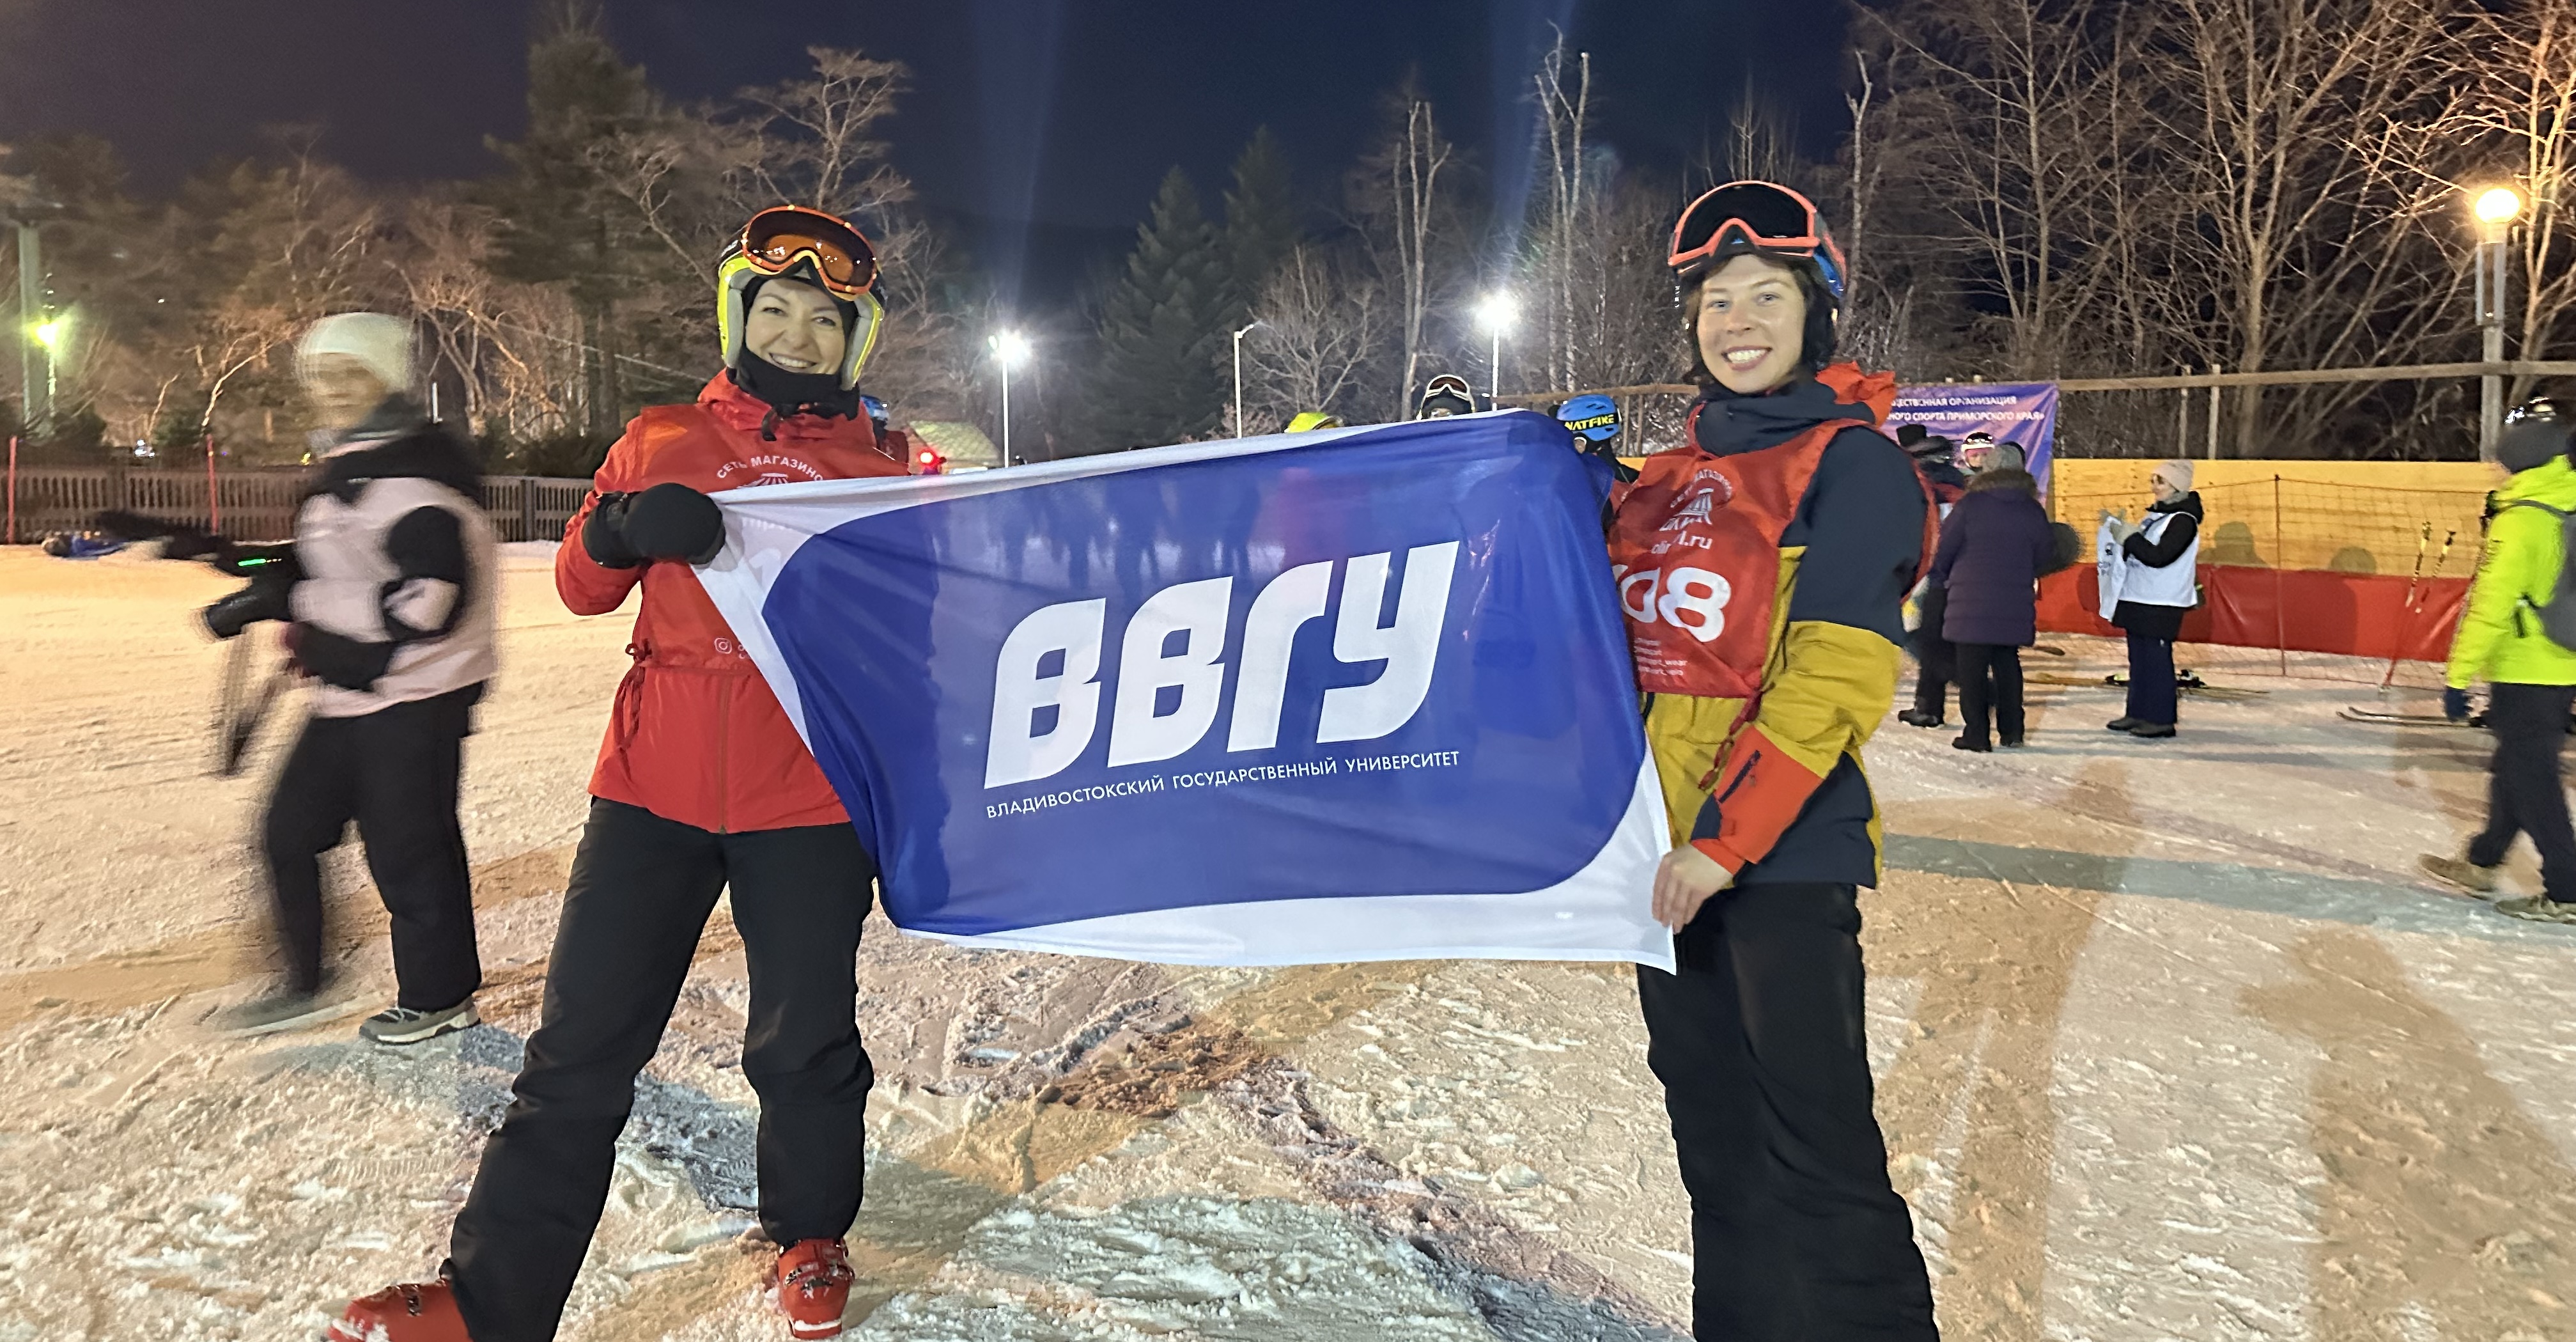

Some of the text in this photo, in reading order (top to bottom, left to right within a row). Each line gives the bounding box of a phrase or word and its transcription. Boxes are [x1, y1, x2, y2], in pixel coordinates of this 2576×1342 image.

[1913, 412, 1946, 421] СПОРТА
[1947, 411, 2014, 421] ПРИМОРСКОГО
[1949, 396, 2017, 406] ОРГАНИЗАЦИЯ
[717, 455, 823, 481] СЕТЬ МАГАЗИНО
[1612, 563, 1732, 643] 08
[984, 541, 1460, 790] ВВГУ
[986, 751, 1460, 818] ВЛАДИВОСТОКСКИЙ ГОСУДАРСТВЕННЫЙ УНИВЕРСИТЕТ
